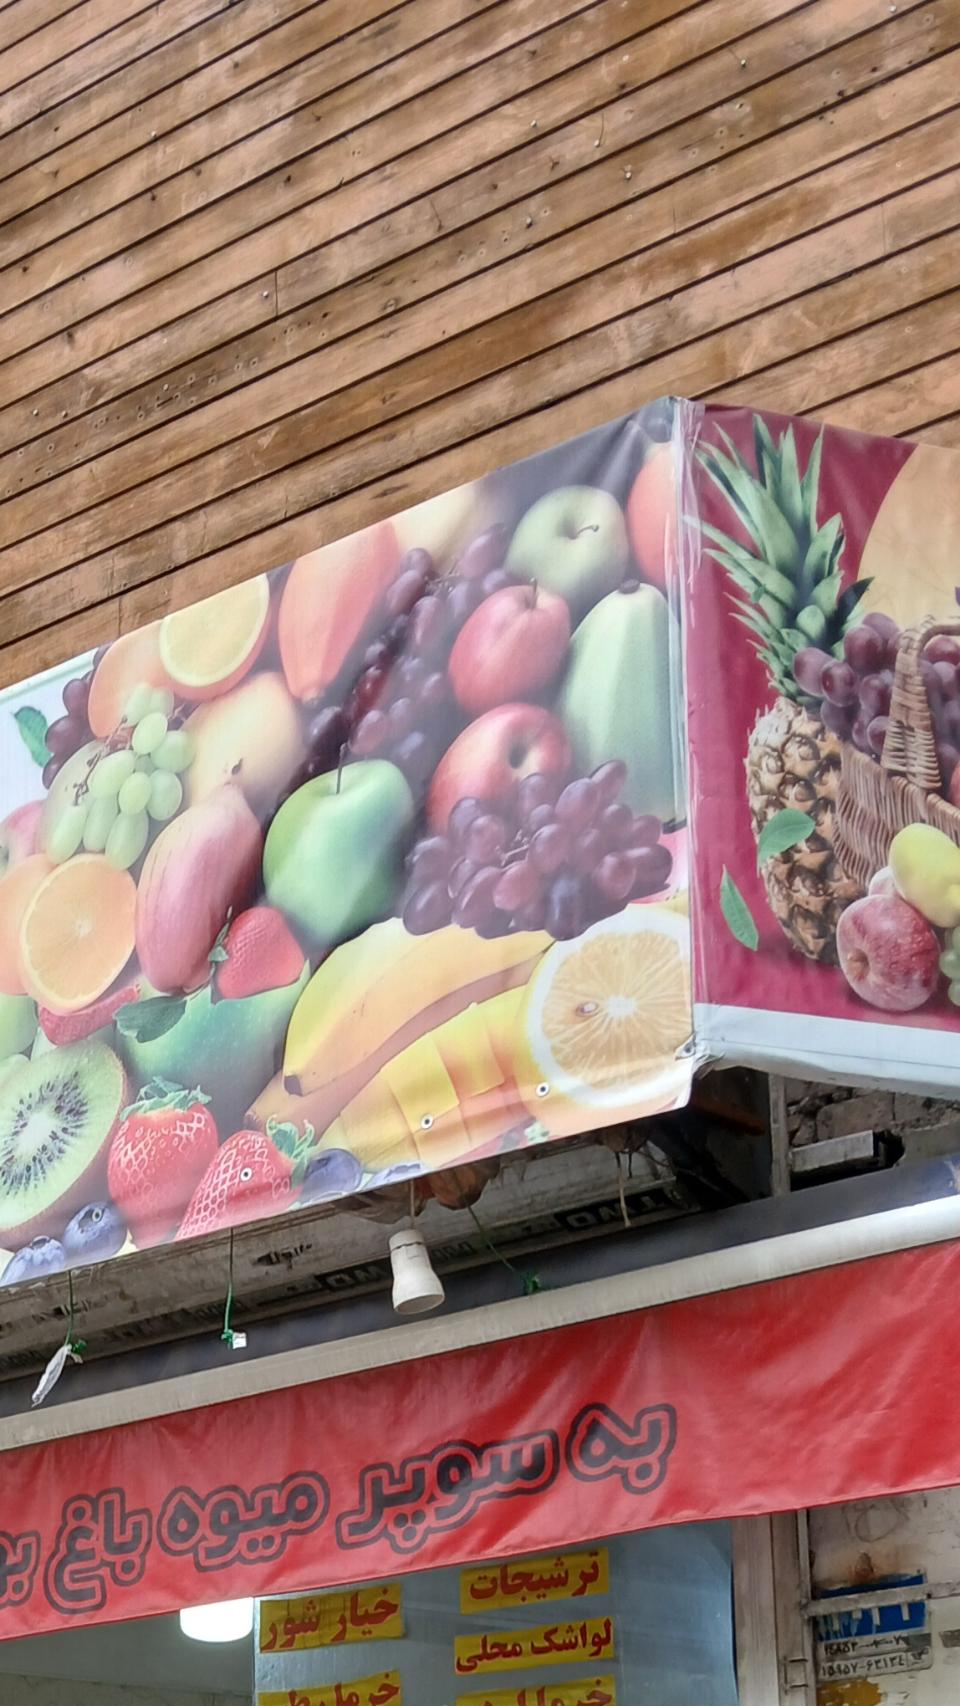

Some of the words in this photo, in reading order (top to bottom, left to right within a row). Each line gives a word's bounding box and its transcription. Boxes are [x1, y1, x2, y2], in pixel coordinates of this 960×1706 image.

[566, 1403, 677, 1494] به
[336, 1431, 558, 1552] سوپر
[157, 1471, 329, 1570] میوه
[44, 1488, 151, 1614] باغ
[469, 1550, 599, 1603] ترشیجات
[261, 1600, 321, 1650] شور
[332, 1586, 399, 1641] خیار
[530, 1617, 612, 1658] لواشک
[456, 1634, 522, 1673] محلی
